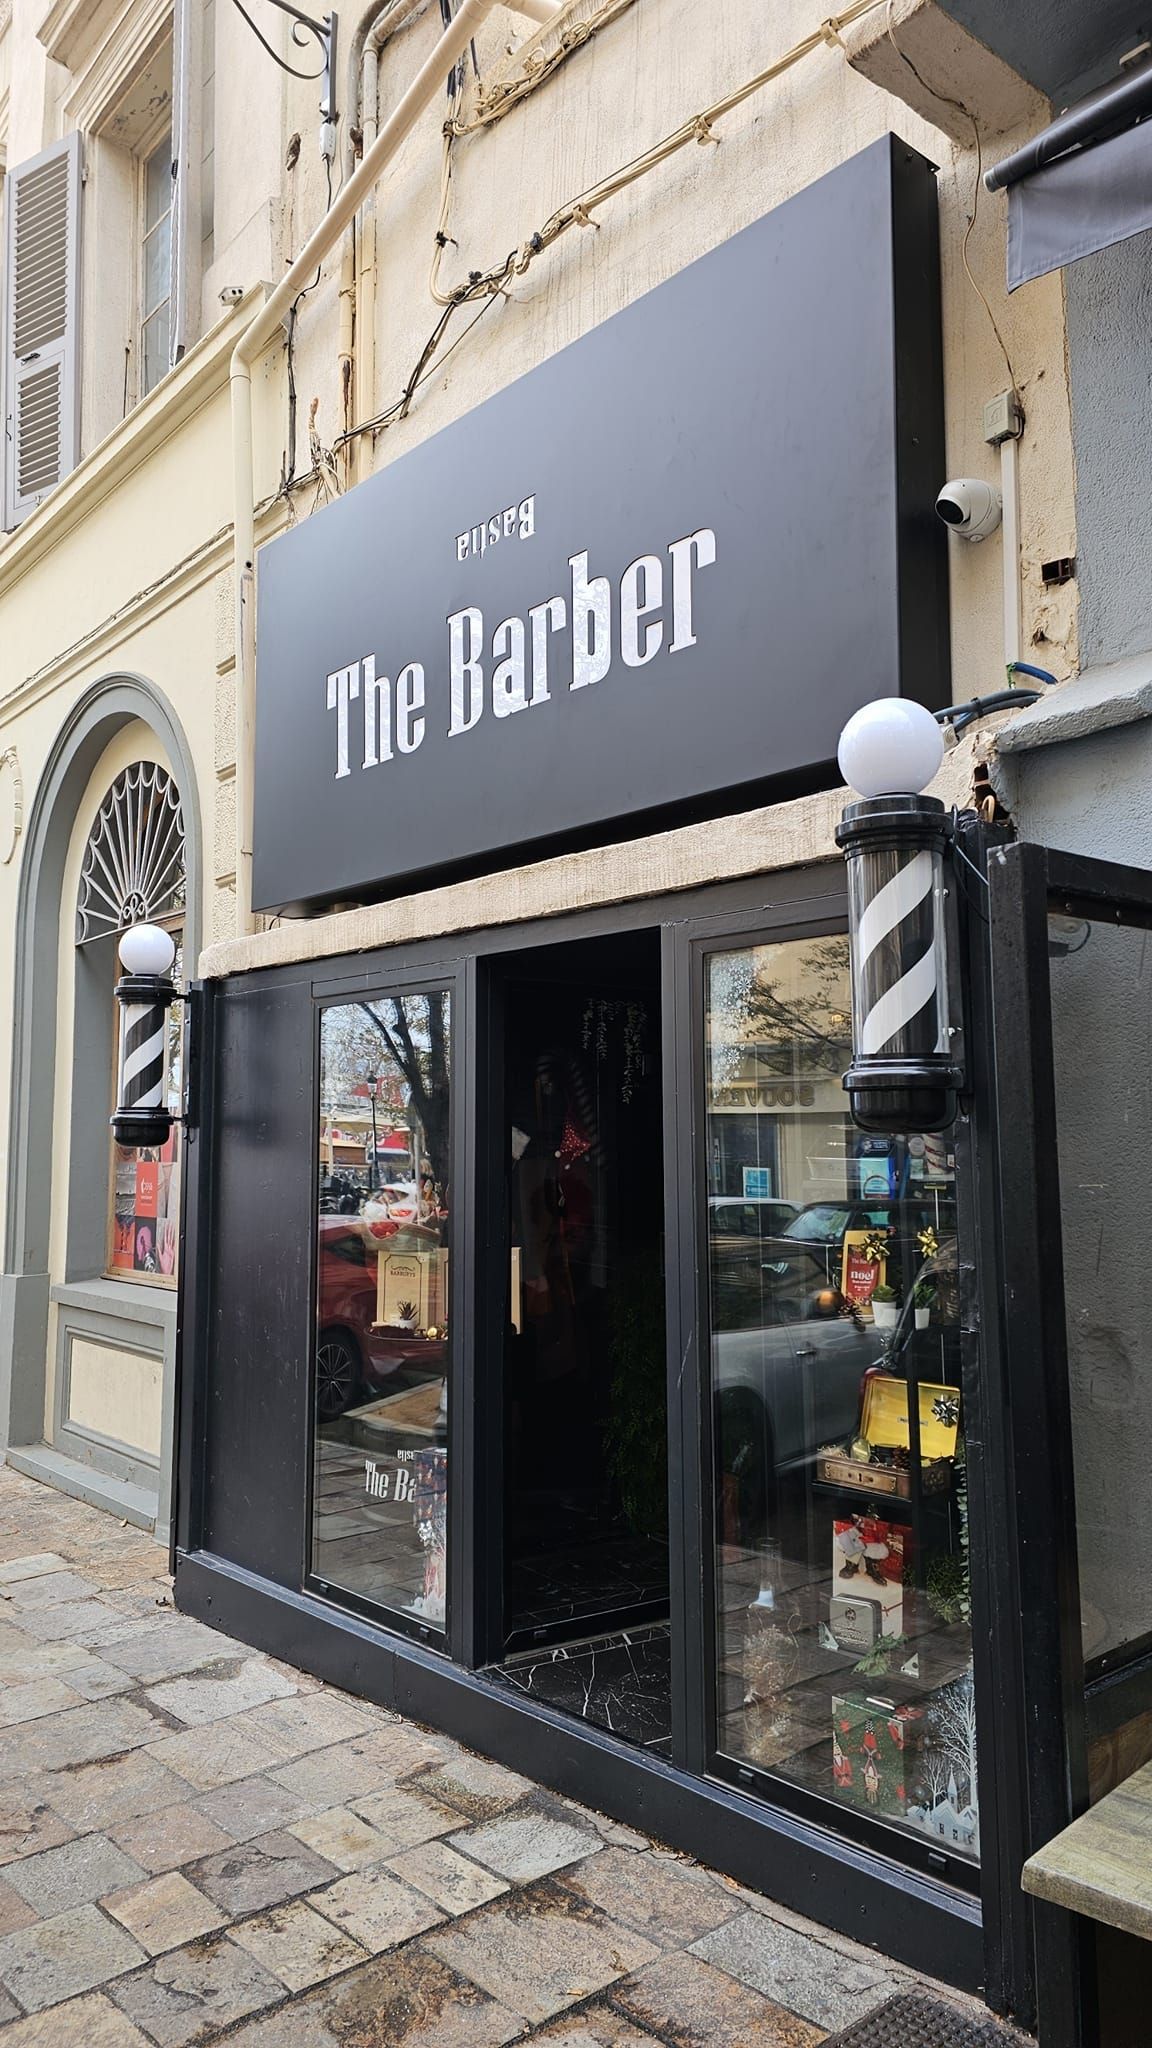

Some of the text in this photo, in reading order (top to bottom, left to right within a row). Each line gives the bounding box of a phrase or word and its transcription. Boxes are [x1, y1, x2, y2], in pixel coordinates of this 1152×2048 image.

[455, 494, 536, 561] Bastia
[326, 528, 717, 780] The Barber
[365, 1460, 417, 1503] The Ba
